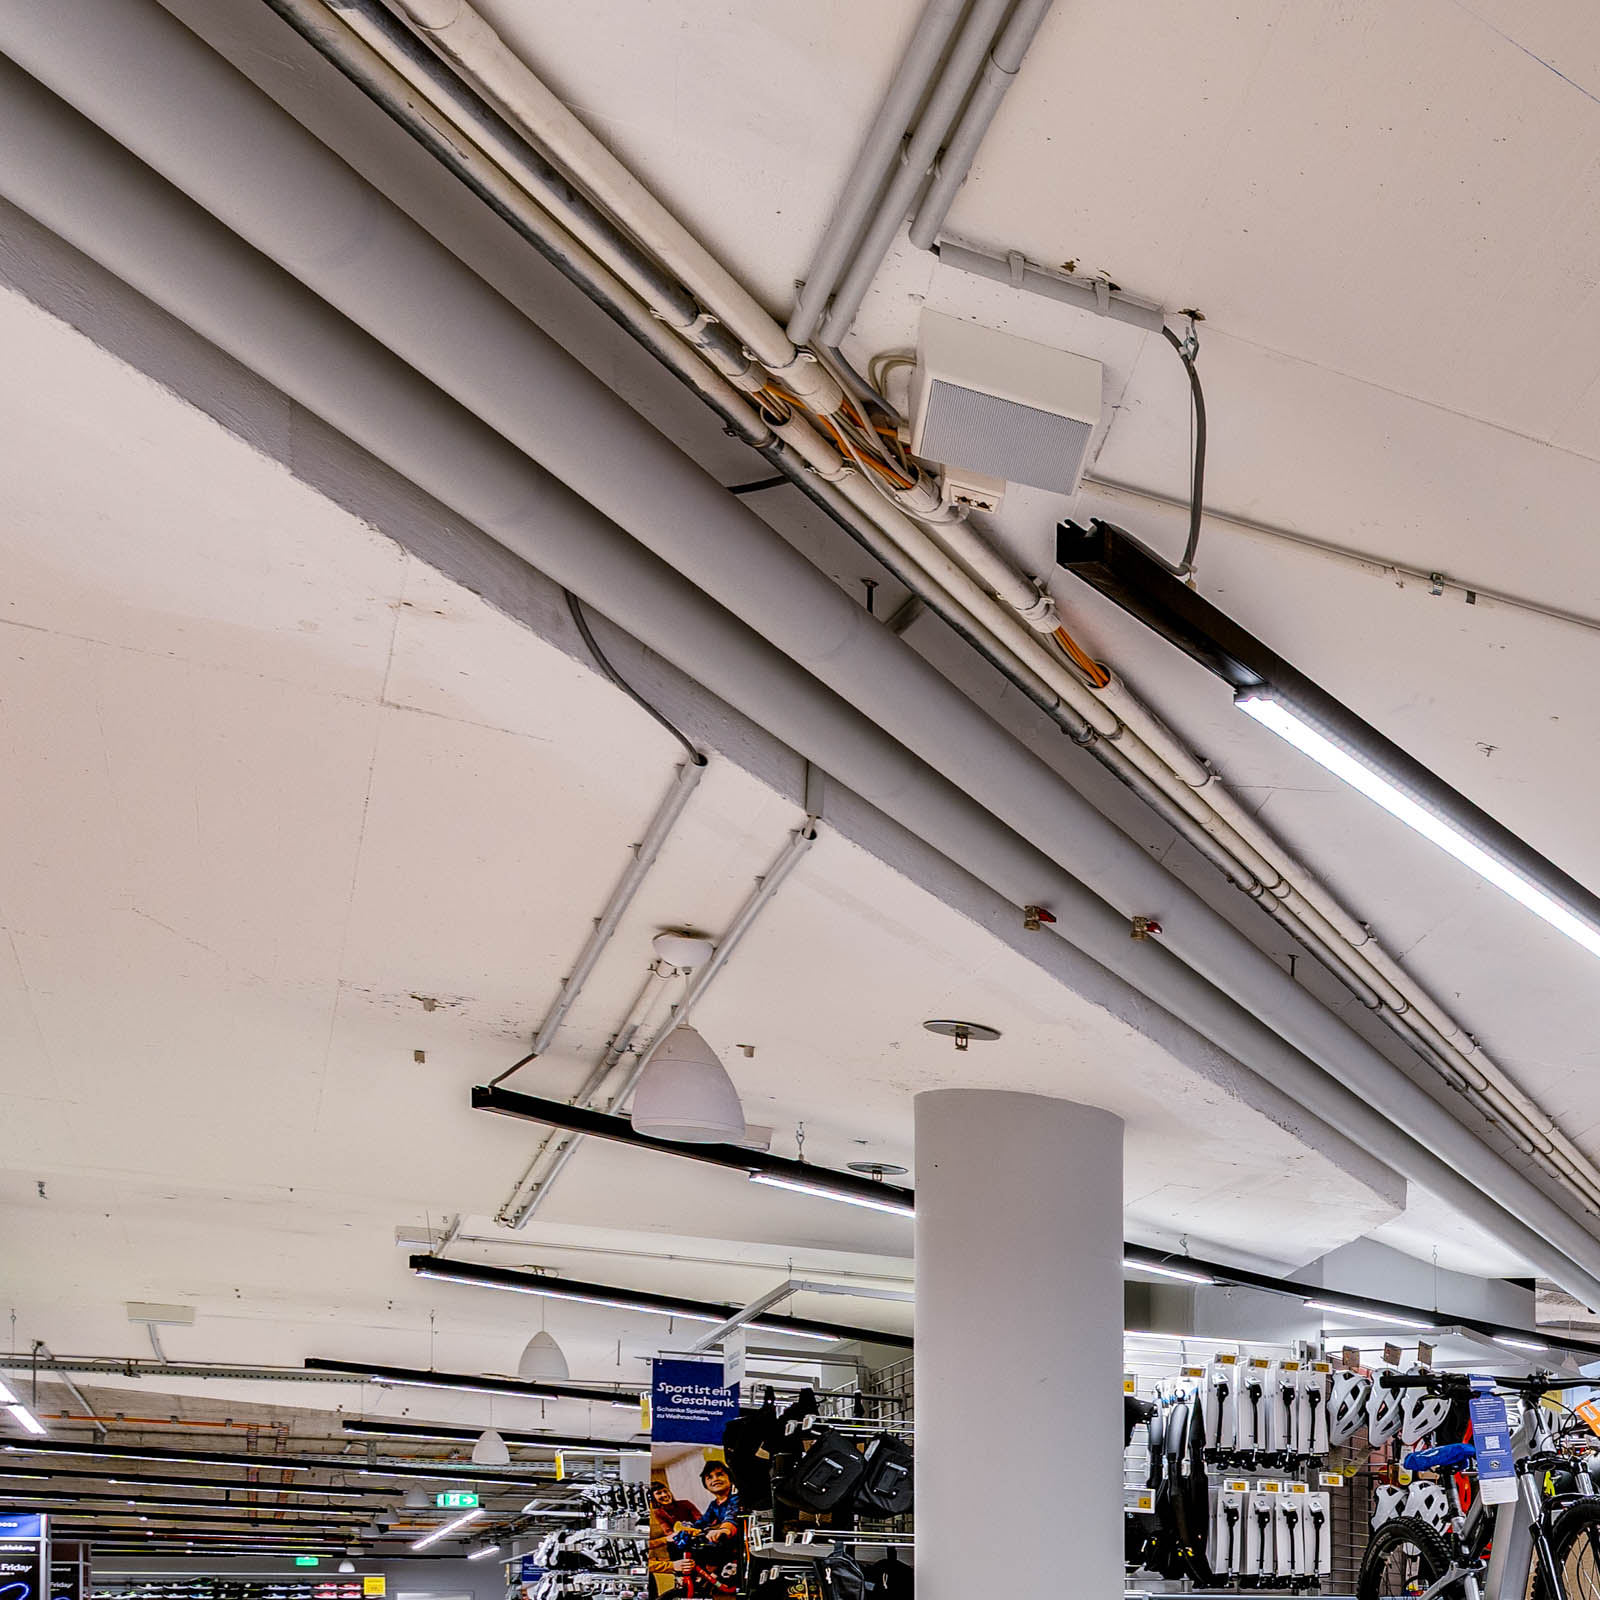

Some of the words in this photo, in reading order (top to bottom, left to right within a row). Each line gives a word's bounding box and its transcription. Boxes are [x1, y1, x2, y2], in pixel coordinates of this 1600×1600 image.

[657, 1382, 693, 1394] Sport
[694, 1385, 711, 1395] ist
[712, 1387, 731, 1396] ein
[671, 1394, 735, 1407] Geschenk
[1, 1563, 33, 1573] Friday
